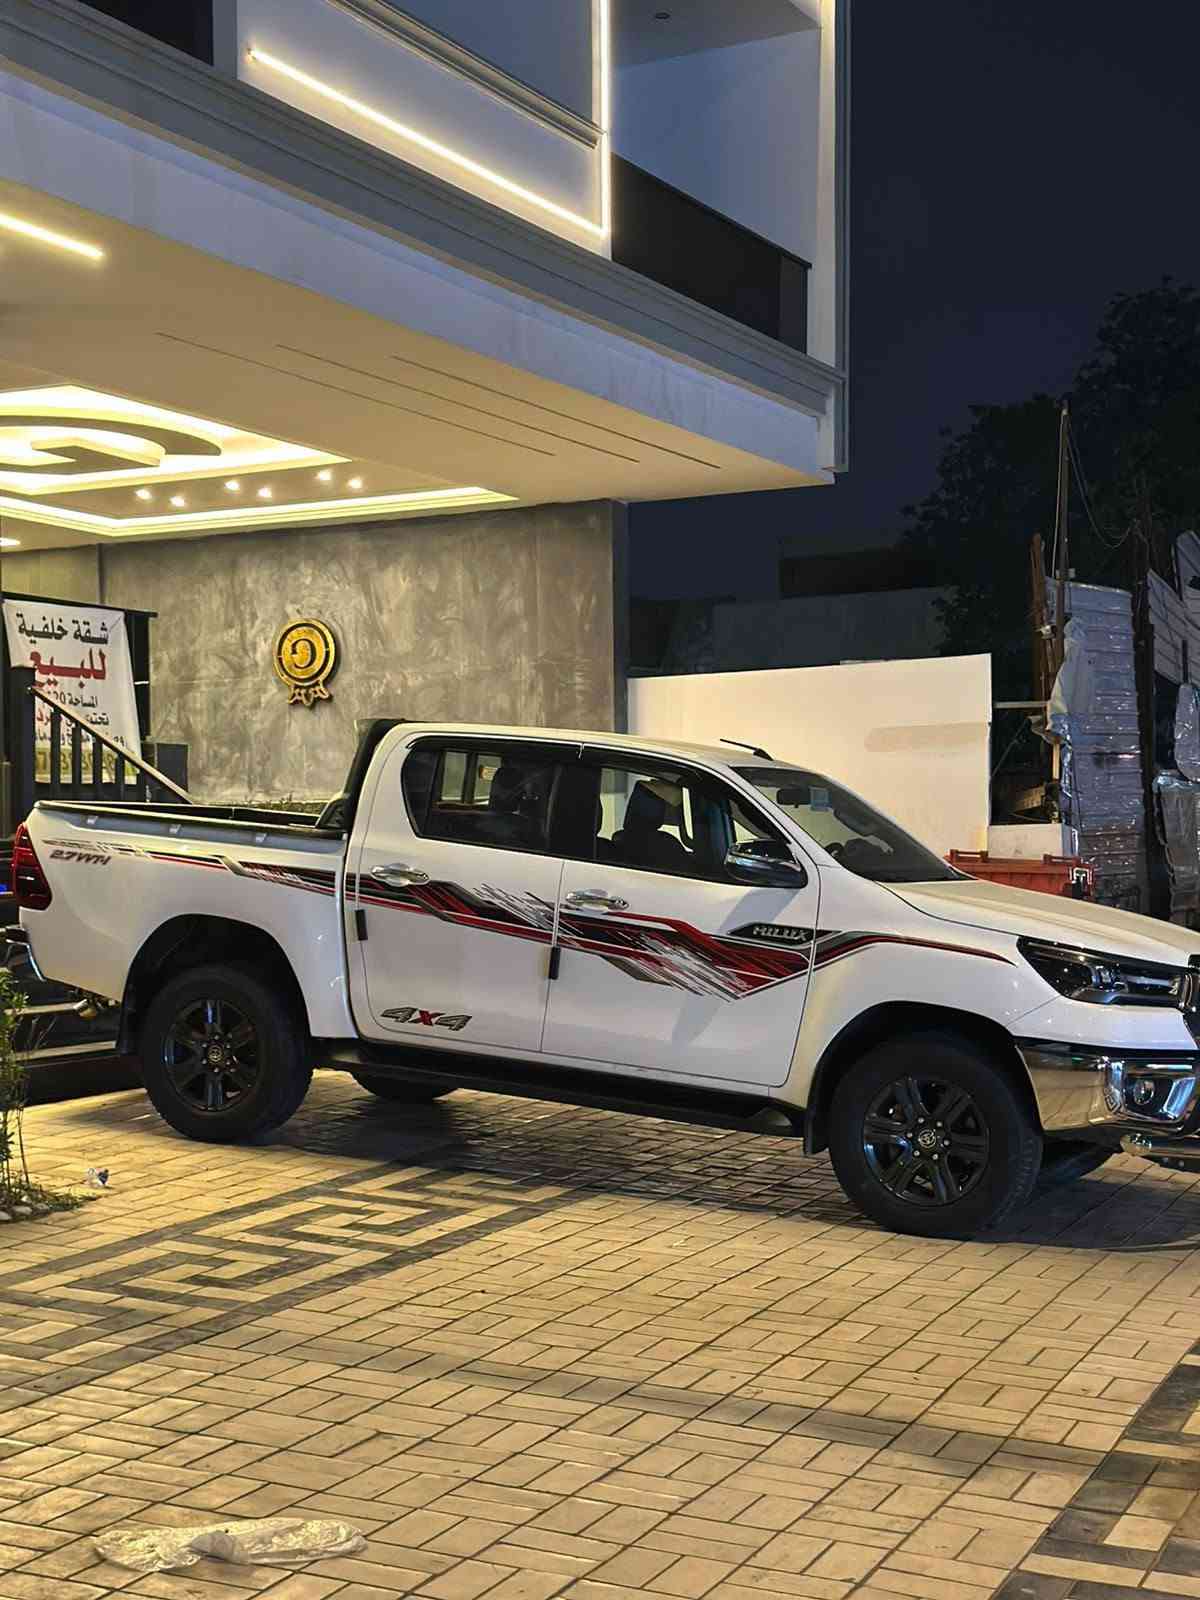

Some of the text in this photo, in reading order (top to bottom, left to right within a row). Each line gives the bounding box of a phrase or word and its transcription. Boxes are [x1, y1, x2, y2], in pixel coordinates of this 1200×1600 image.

[16, 612, 109, 645] شقة خلفية
[30, 648, 106, 689] للبيع
[68, 692, 98, 708] المساحة
[753, 925, 808, 941] HILUX
